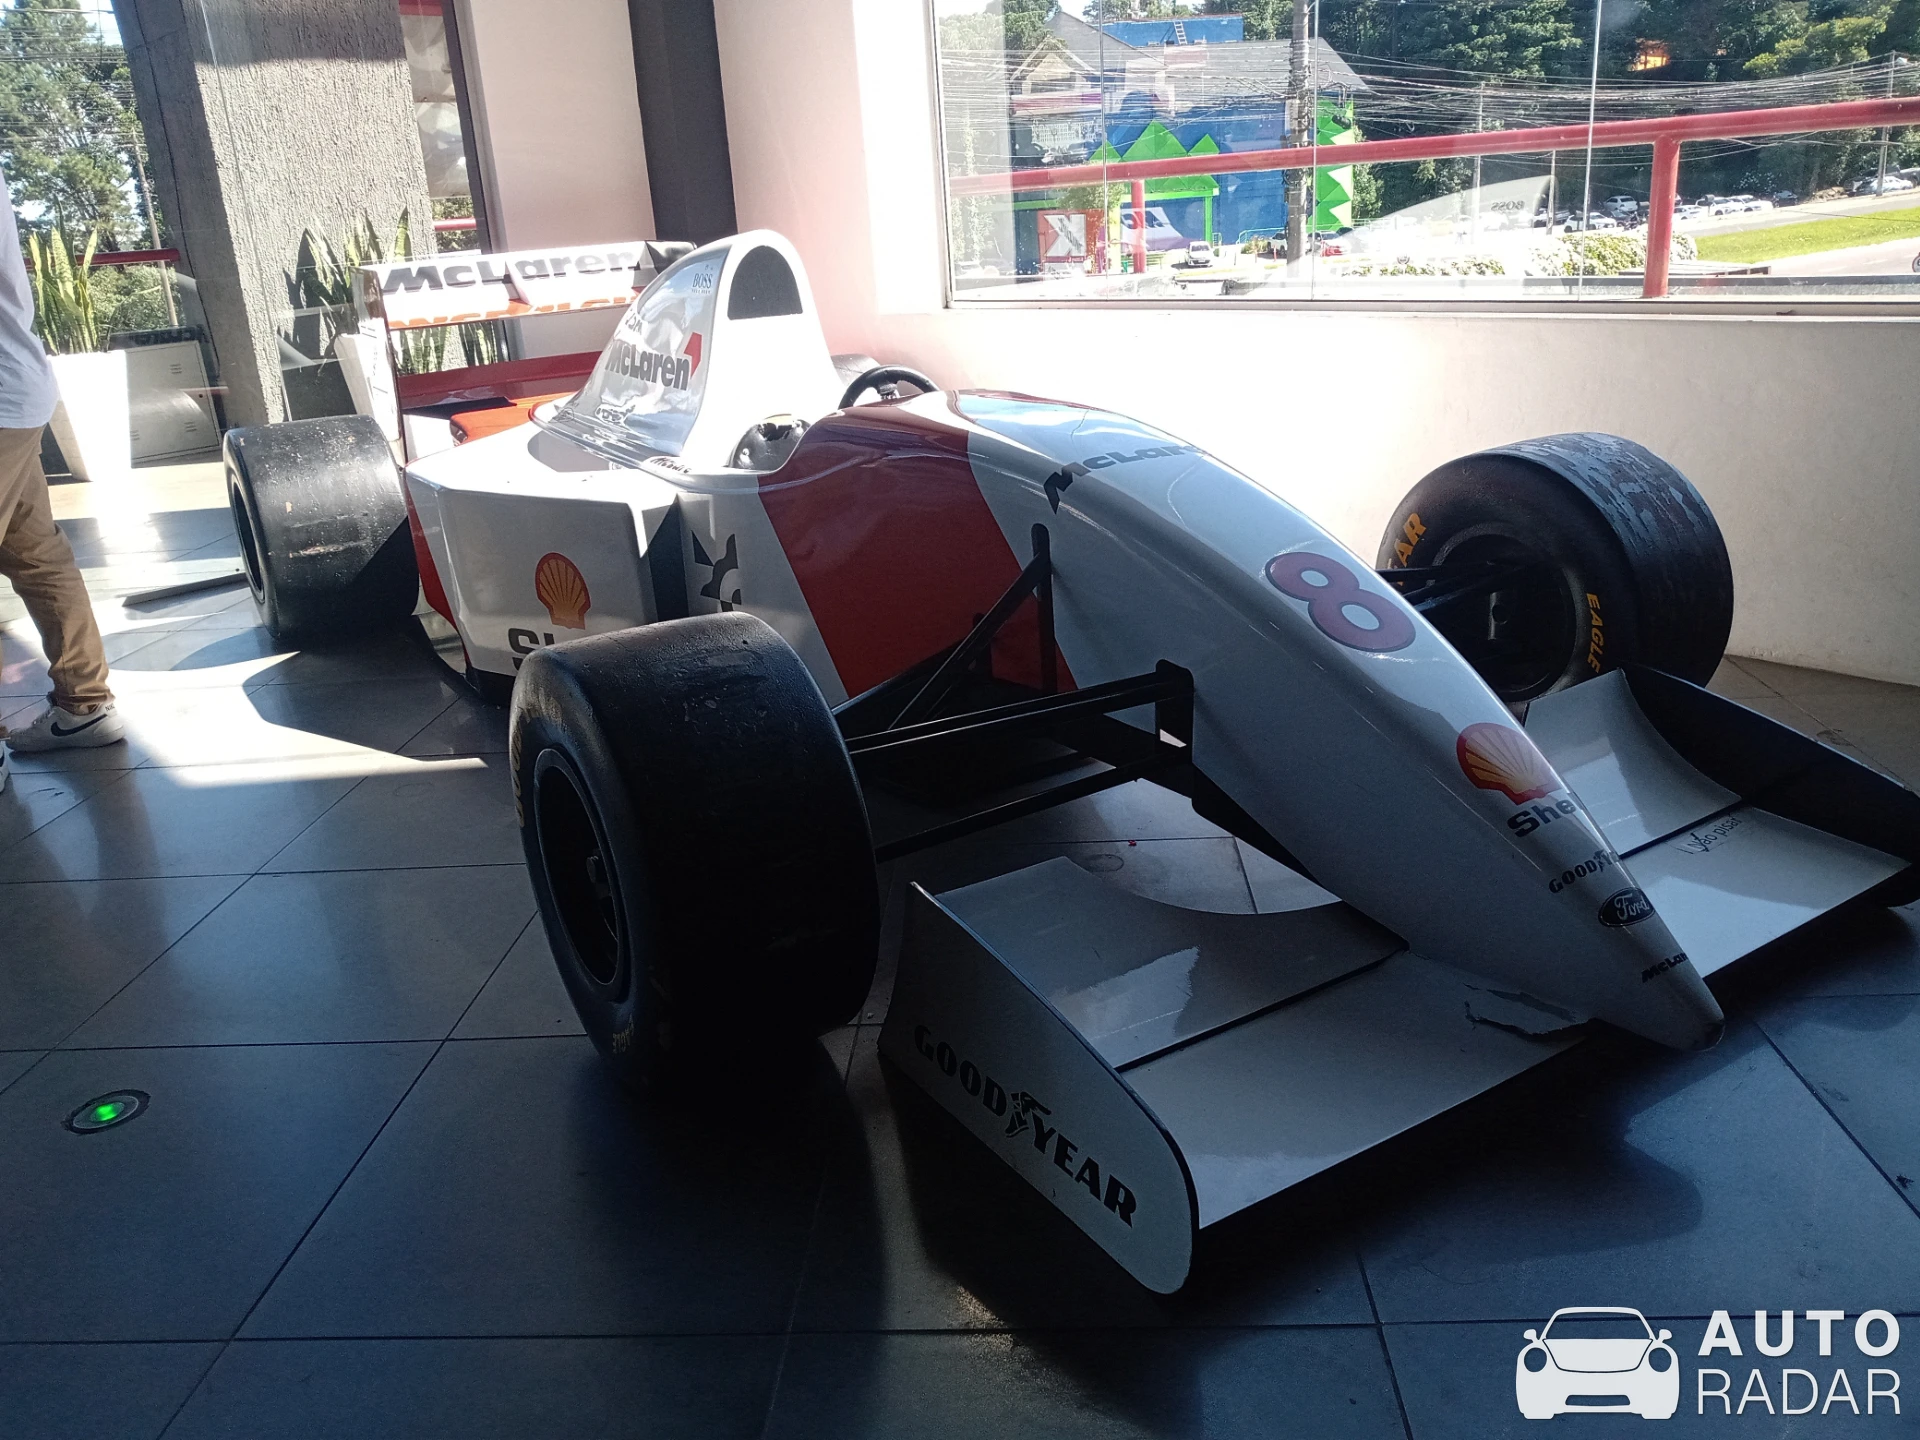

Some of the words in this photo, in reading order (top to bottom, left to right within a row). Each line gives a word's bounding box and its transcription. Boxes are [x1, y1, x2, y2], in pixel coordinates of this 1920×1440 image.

[383, 250, 639, 294] McLaren
[692, 273, 713, 289] BOSS
[605, 343, 690, 391] McLaren
[1265, 551, 1416, 653] 8
[1586, 593, 1605, 674] EAGLE
[1507, 800, 1577, 838] She
[1614, 893, 1650, 921] Ford
